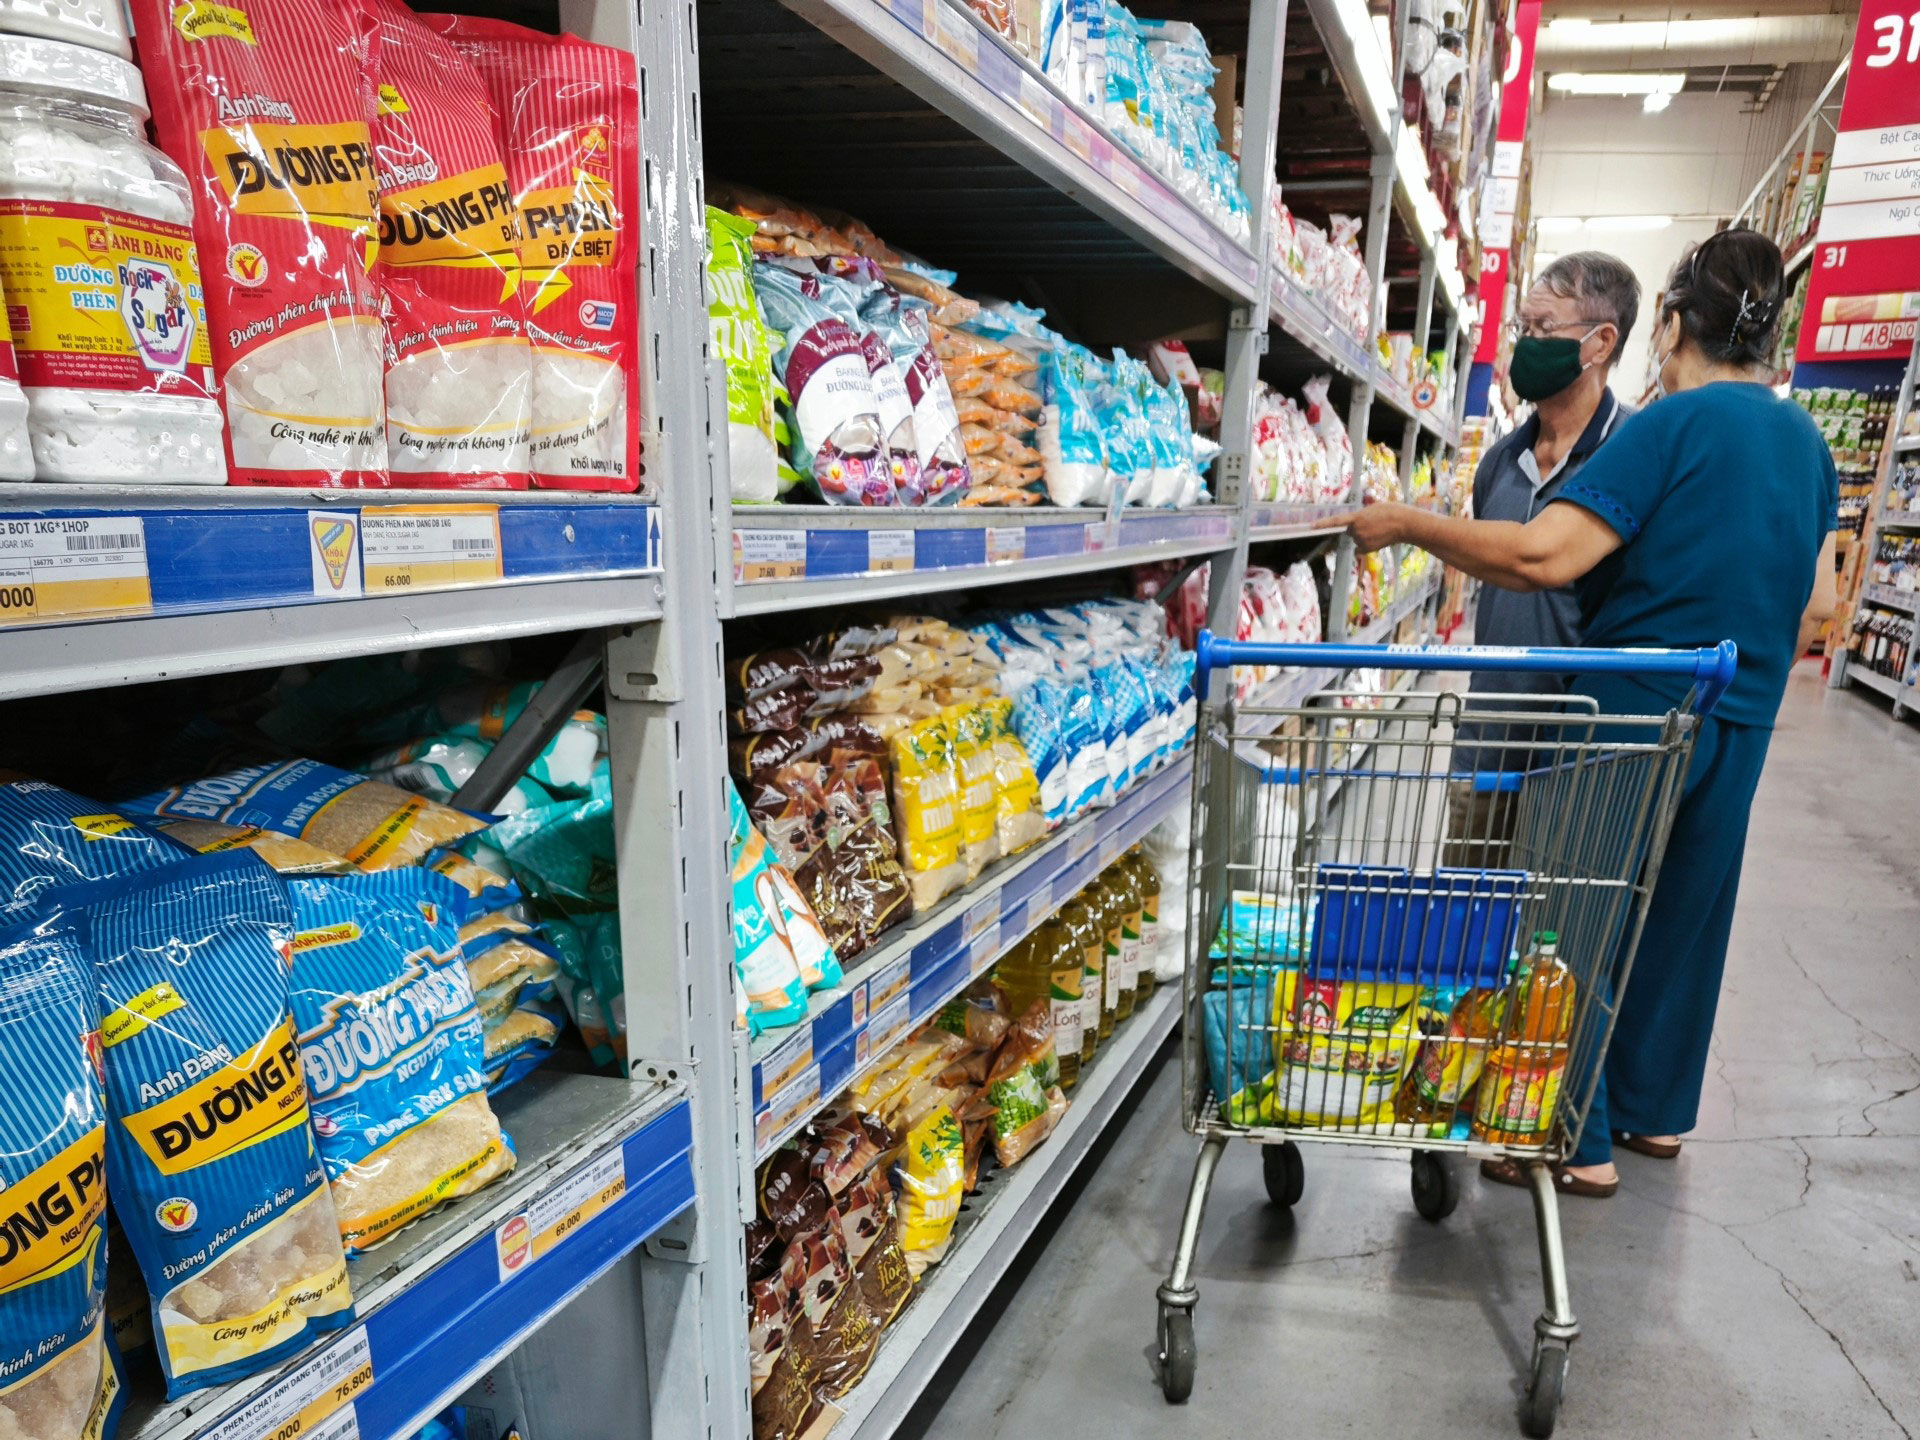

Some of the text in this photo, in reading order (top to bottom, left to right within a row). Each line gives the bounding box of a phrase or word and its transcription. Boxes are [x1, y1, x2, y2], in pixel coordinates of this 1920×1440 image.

[218, 94, 297, 124] Anh Đăng
[1880, 132, 1900, 145] Bột
[225, 139, 346, 195] ĐƯỜNG
[397, 160, 437, 182] Đăng
[112, 233, 140, 254] ANH
[584, 238, 613, 260] BIỆT
[1822, 246, 1847, 269] 31
[55, 263, 114, 285] ĐƯỜNG
[72, 287, 117, 309] PHÈN
[131, 298, 186, 339] Sugar
[229, 317, 275, 349] Đường
[277, 297, 306, 327] phèn
[309, 290, 337, 312] chính
[400, 331, 425, 350] phèn
[428, 319, 453, 338] chính
[456, 318, 478, 332] hiệu
[271, 421, 304, 444] Công
[471, 433, 506, 452] không
[553, 430, 579, 450] dụng
[571, 456, 589, 470] Khối
[613, 460, 623, 475] kg
[9, 521, 31, 535] BOT
[362, 520, 385, 529] DUONG
[385, 520, 401, 528] PHEN
[402, 520, 416, 528] ANH
[416, 519, 432, 528] DANG
[385, 575, 411, 587] 66.000
[282, 800, 316, 829] PURE
[291, 936, 319, 950] ANH
[105, 1013, 132, 1042] Special
[302, 995, 418, 1095] ĐƯỜNG
[140, 1042, 233, 1104] Anh Đăng
[150, 1054, 286, 1160] ĐƯỜNG
[556, 1180, 625, 1237] 69.000 67.000
[163, 1249, 207, 1280] Đường
[208, 1225, 237, 1256] phèn
[239, 1202, 273, 1230] chính
[274, 1187, 296, 1207] hiệu
[213, 1325, 248, 1343] Công
[251, 1311, 280, 1334] nghệ
[37, 1333, 66, 1358] hiệu
[222, 1416, 245, 1436] PHEN
[245, 1397, 273, 1419] N.CHAT
[273, 1382, 291, 1400] ANH
[290, 1369, 312, 1388] DANG
[311, 1360, 323, 1373] DB
[323, 1350, 337, 1366] 1KG
[335, 1366, 373, 1402] 76.800
